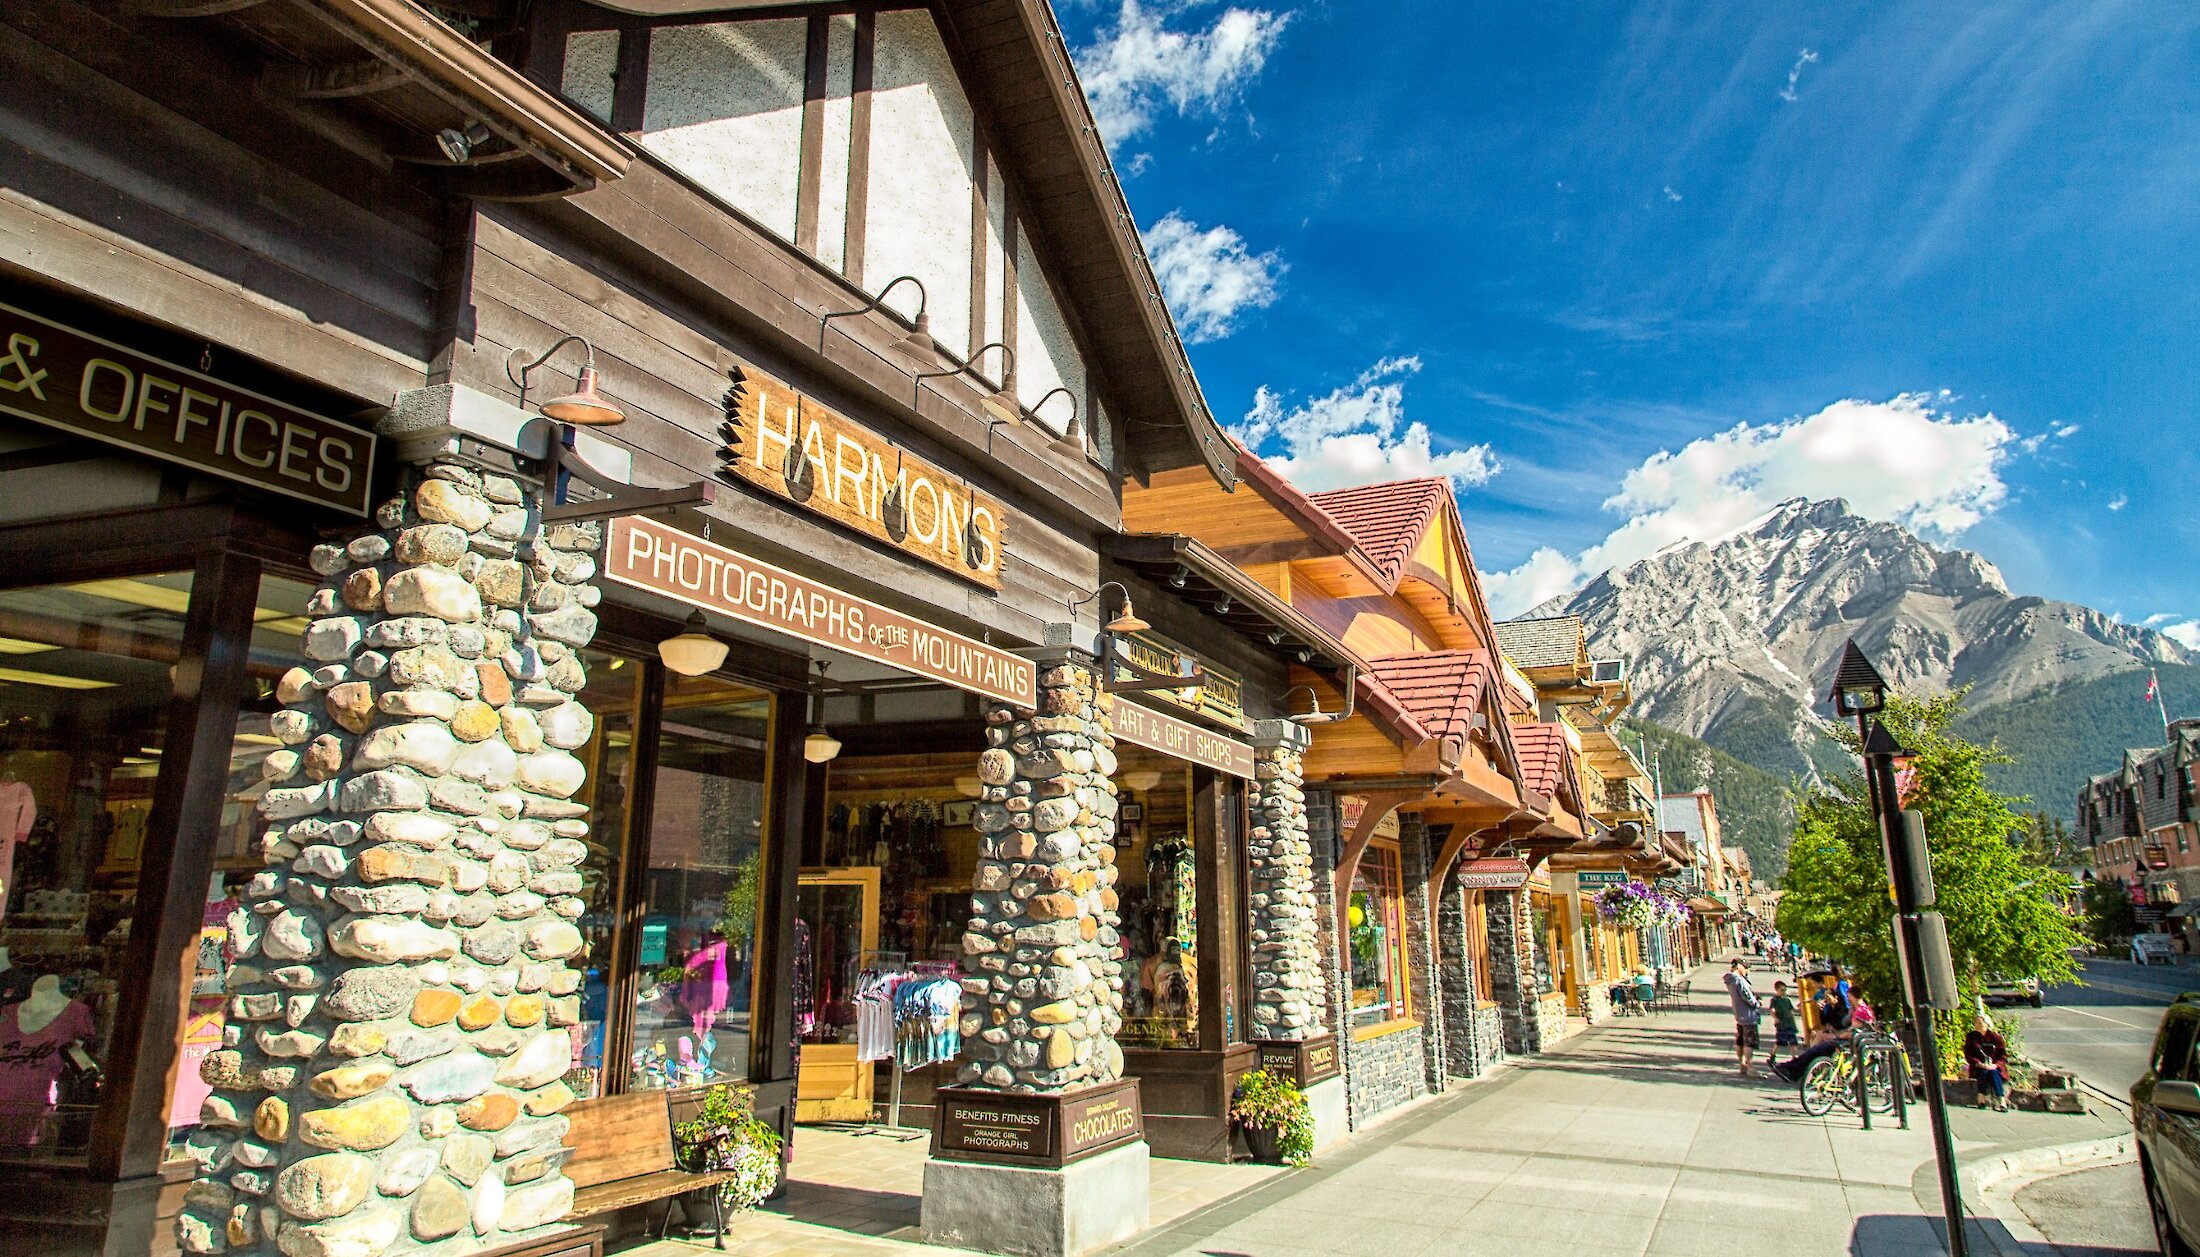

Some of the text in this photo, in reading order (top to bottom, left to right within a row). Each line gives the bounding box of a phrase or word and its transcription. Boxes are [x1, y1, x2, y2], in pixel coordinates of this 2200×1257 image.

[0, 332, 354, 493] & OFFICES
[755, 392, 995, 571] HARMONS
[628, 528, 1028, 696] PHOTOGRAPHS OF THE MOUNTAINS
[1119, 706, 1232, 766] ART & GIFT SHOPS
[1263, 1055, 1294, 1064] REVIVE
[955, 1109, 1040, 1125] BENEFITS FITNESS
[974, 1129, 1018, 1140] ORANGE GIRL
[1073, 1107, 1134, 1144] CHOCOLATES
[963, 1136, 1029, 1149] PHOTOGRAPHS
